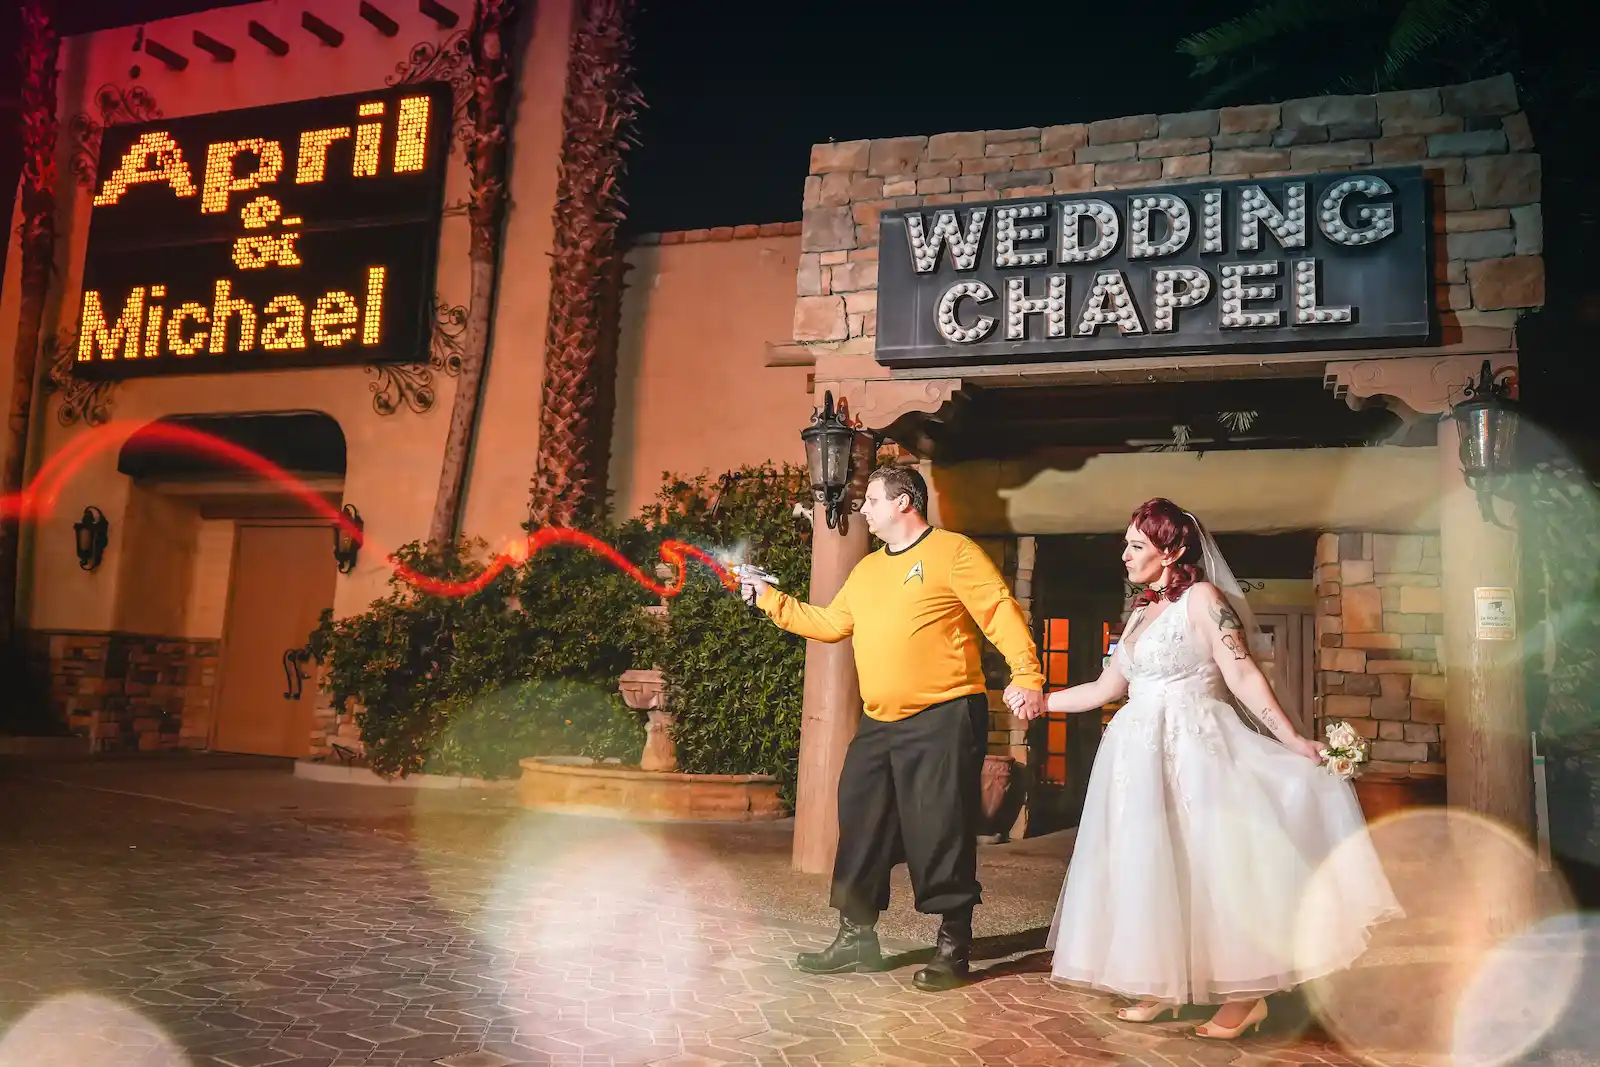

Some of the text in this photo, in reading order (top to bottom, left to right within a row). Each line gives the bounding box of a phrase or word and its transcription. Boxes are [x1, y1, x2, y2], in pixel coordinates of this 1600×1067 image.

[93, 95, 430, 214] April
[232, 195, 302, 269] &
[904, 174, 1395, 273] WEDDING
[77, 265, 386, 362] Michael
[934, 256, 1355, 343] CHAPEL
